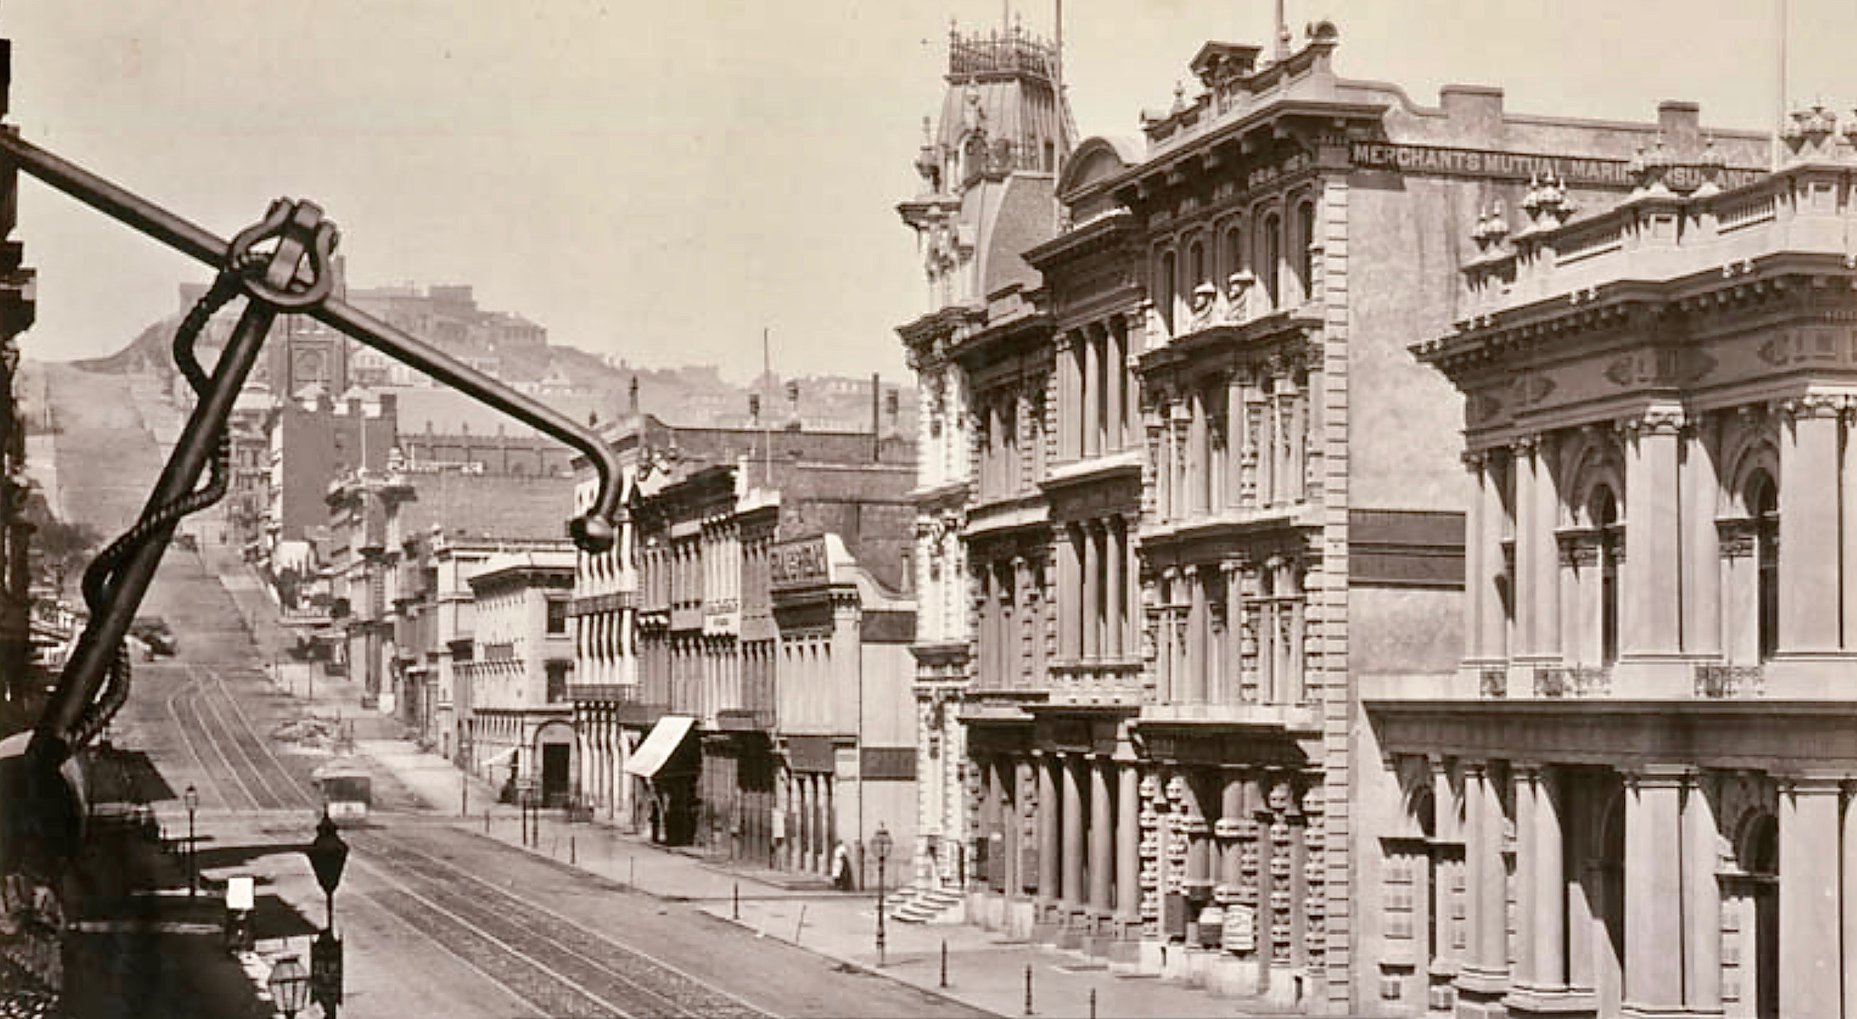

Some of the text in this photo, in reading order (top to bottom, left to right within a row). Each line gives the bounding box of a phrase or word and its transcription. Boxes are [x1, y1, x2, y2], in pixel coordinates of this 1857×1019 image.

[1353, 143, 1481, 172] MERCHANTS
[1485, 153, 1567, 177] MUTUAL
[1571, 159, 1638, 186] MARI
